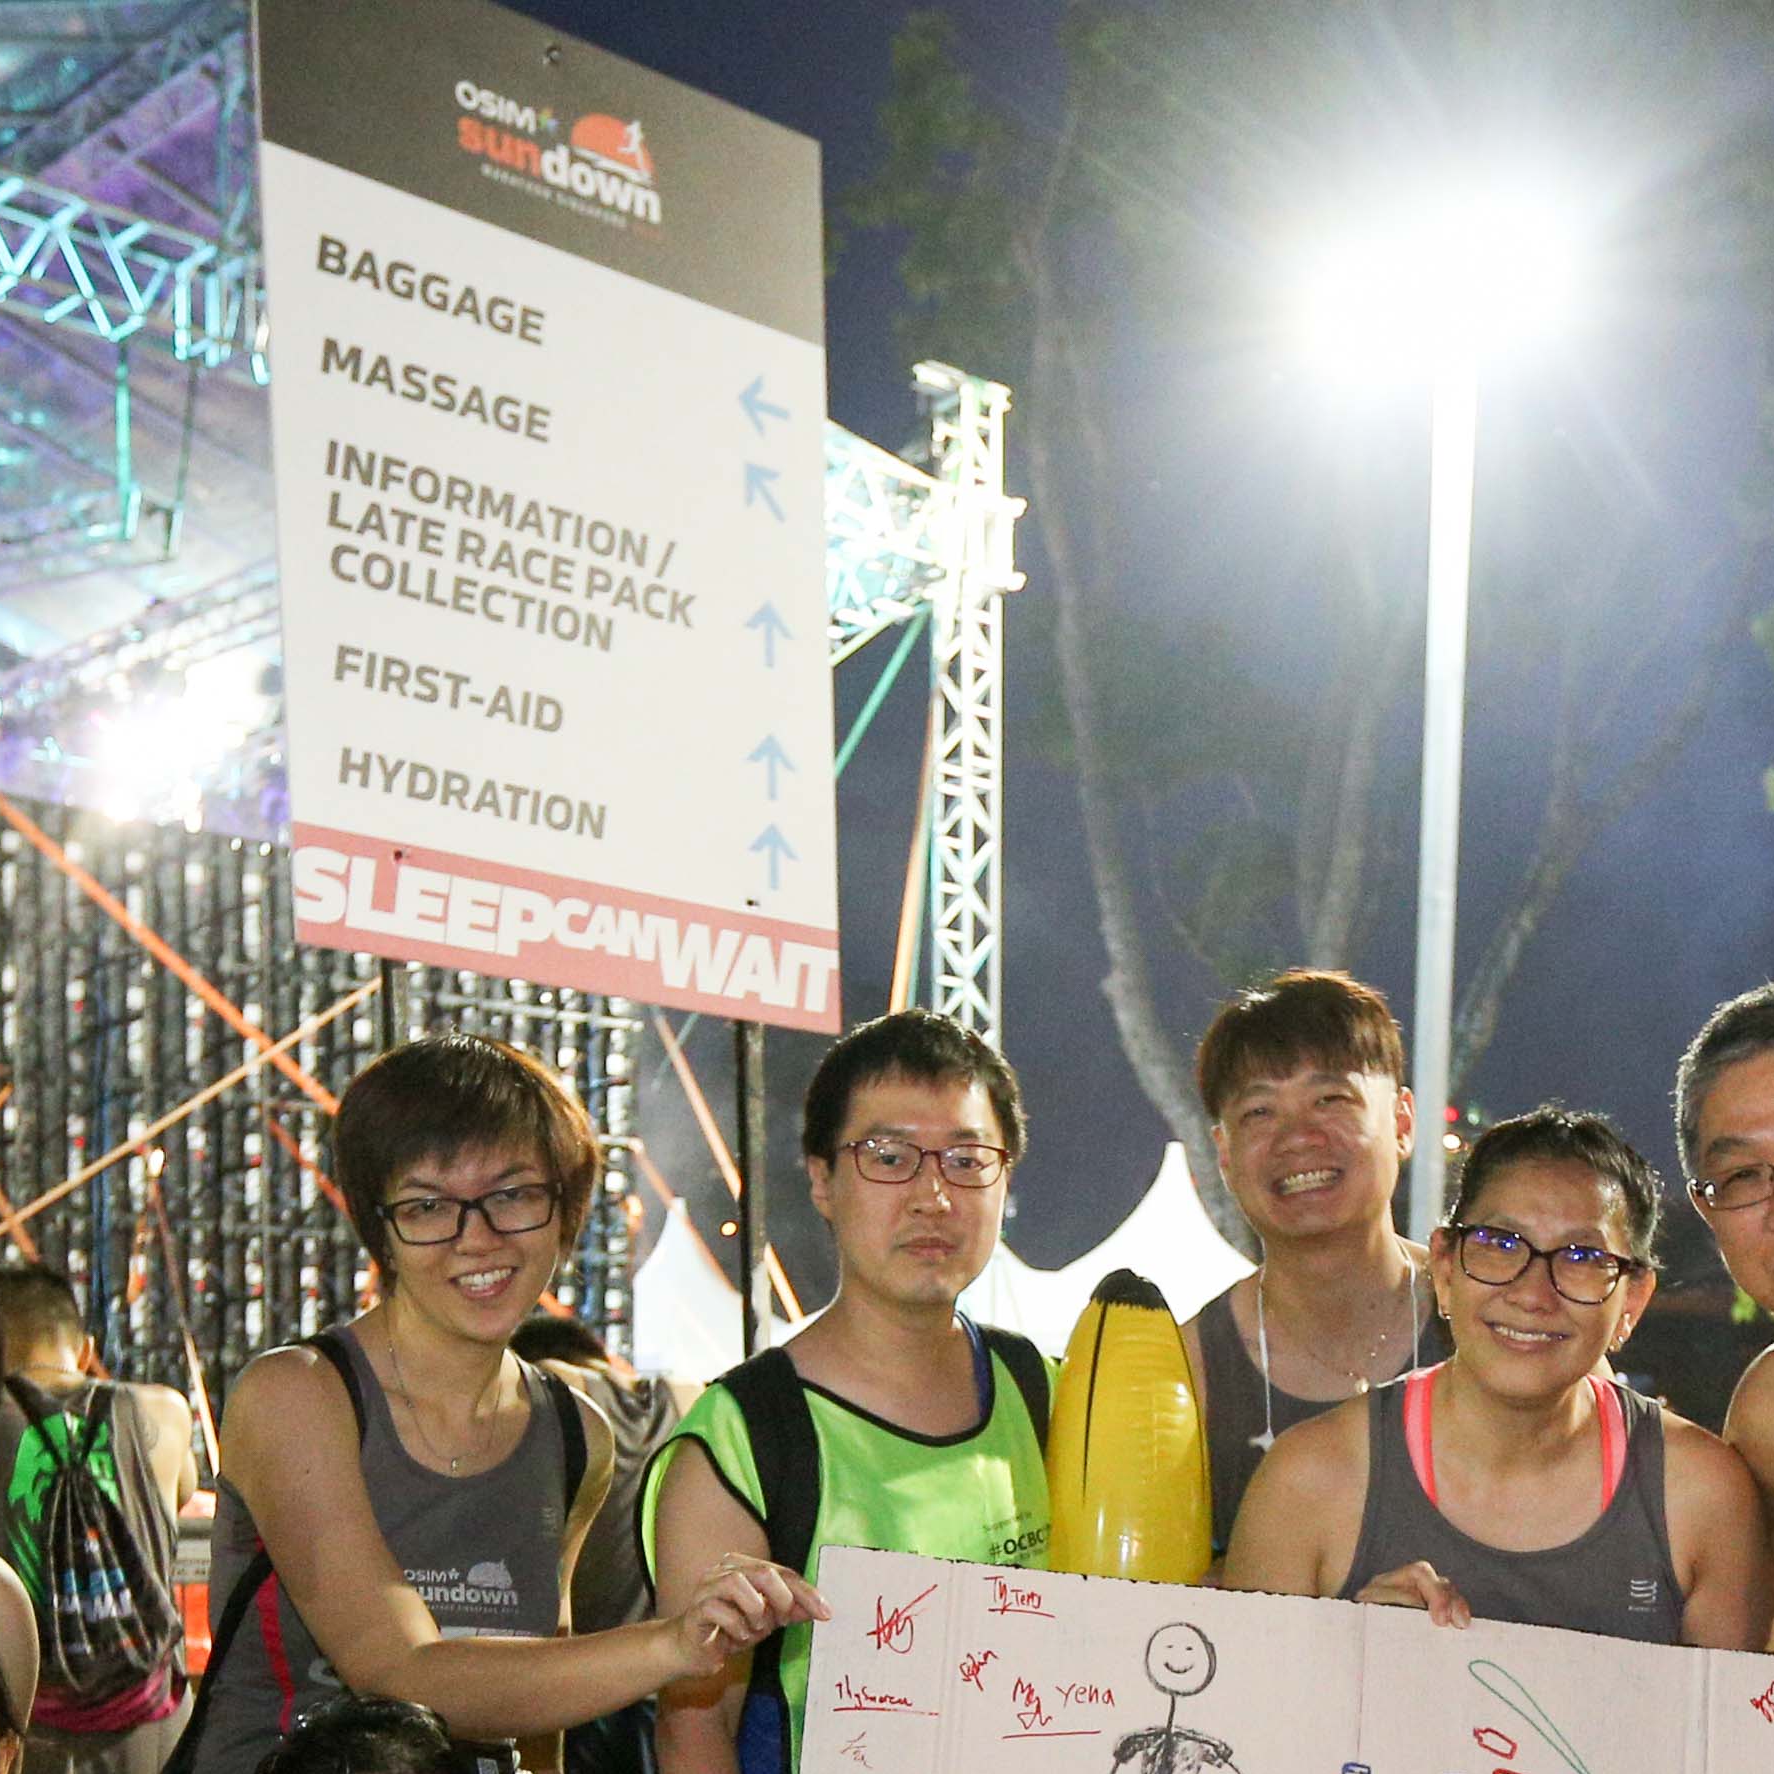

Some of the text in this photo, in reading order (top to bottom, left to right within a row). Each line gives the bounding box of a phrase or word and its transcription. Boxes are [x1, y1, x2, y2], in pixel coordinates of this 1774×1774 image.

[454, 80, 537, 135] OSIM
[457, 116, 662, 225] sundown
[316, 234, 545, 345] BAGGAGE
[321, 337, 551, 442] MASSAGE
[325, 439, 677, 578] INFORMATION /
[328, 490, 697, 628] LATE RACE PACK
[330, 543, 614, 652] COLLECTION
[333, 645, 564, 733] FIRST-AID
[338, 747, 607, 840] HYDRATION
[404, 1568, 447, 1583] OSIM
[417, 1582, 519, 1606] undown
